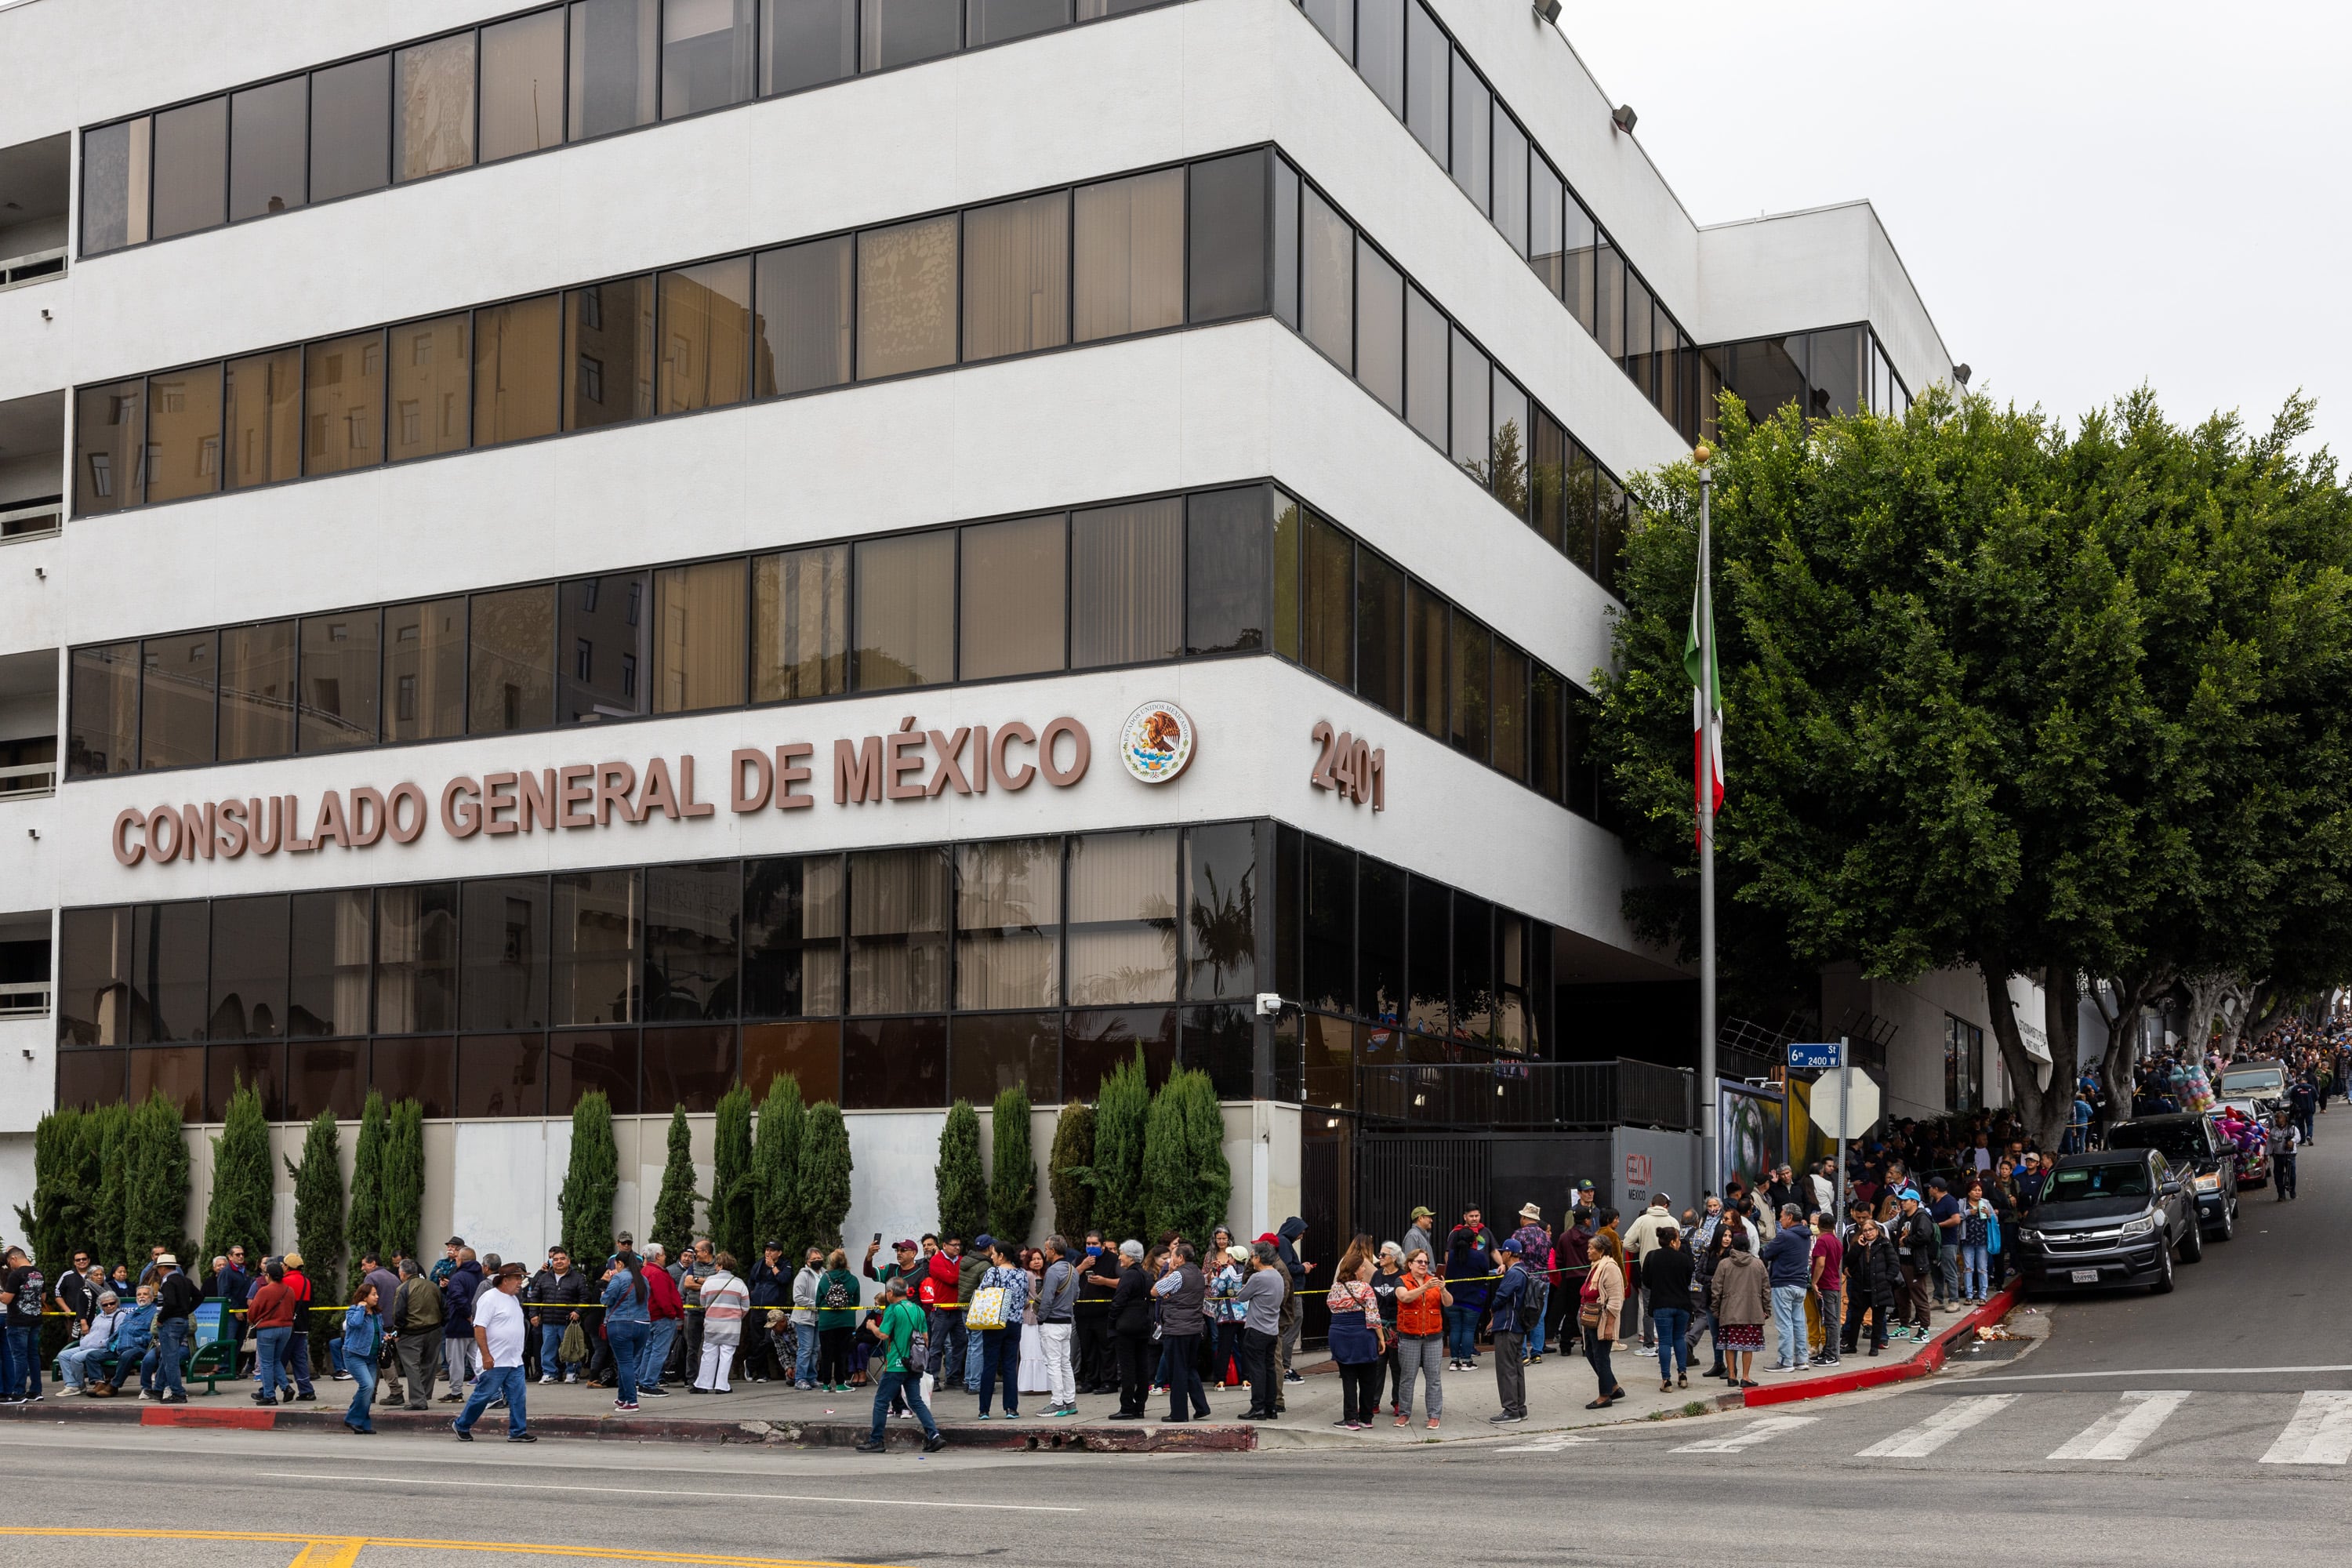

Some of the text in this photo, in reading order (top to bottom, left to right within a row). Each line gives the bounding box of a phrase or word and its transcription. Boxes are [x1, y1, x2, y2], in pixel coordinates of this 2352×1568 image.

[1123, 703, 1189, 741] ESTADOS UNIDOS MEXICANOS
[1312, 720, 1385, 812] 2401
[112, 716, 1091, 866] CONSULADO GENERAL DE MÉXICO
[1791, 1045, 1836, 1061] 6th St
[1808, 1057, 1836, 1065] 2400 W
[1628, 1188, 1646, 1200] MÉXICO
